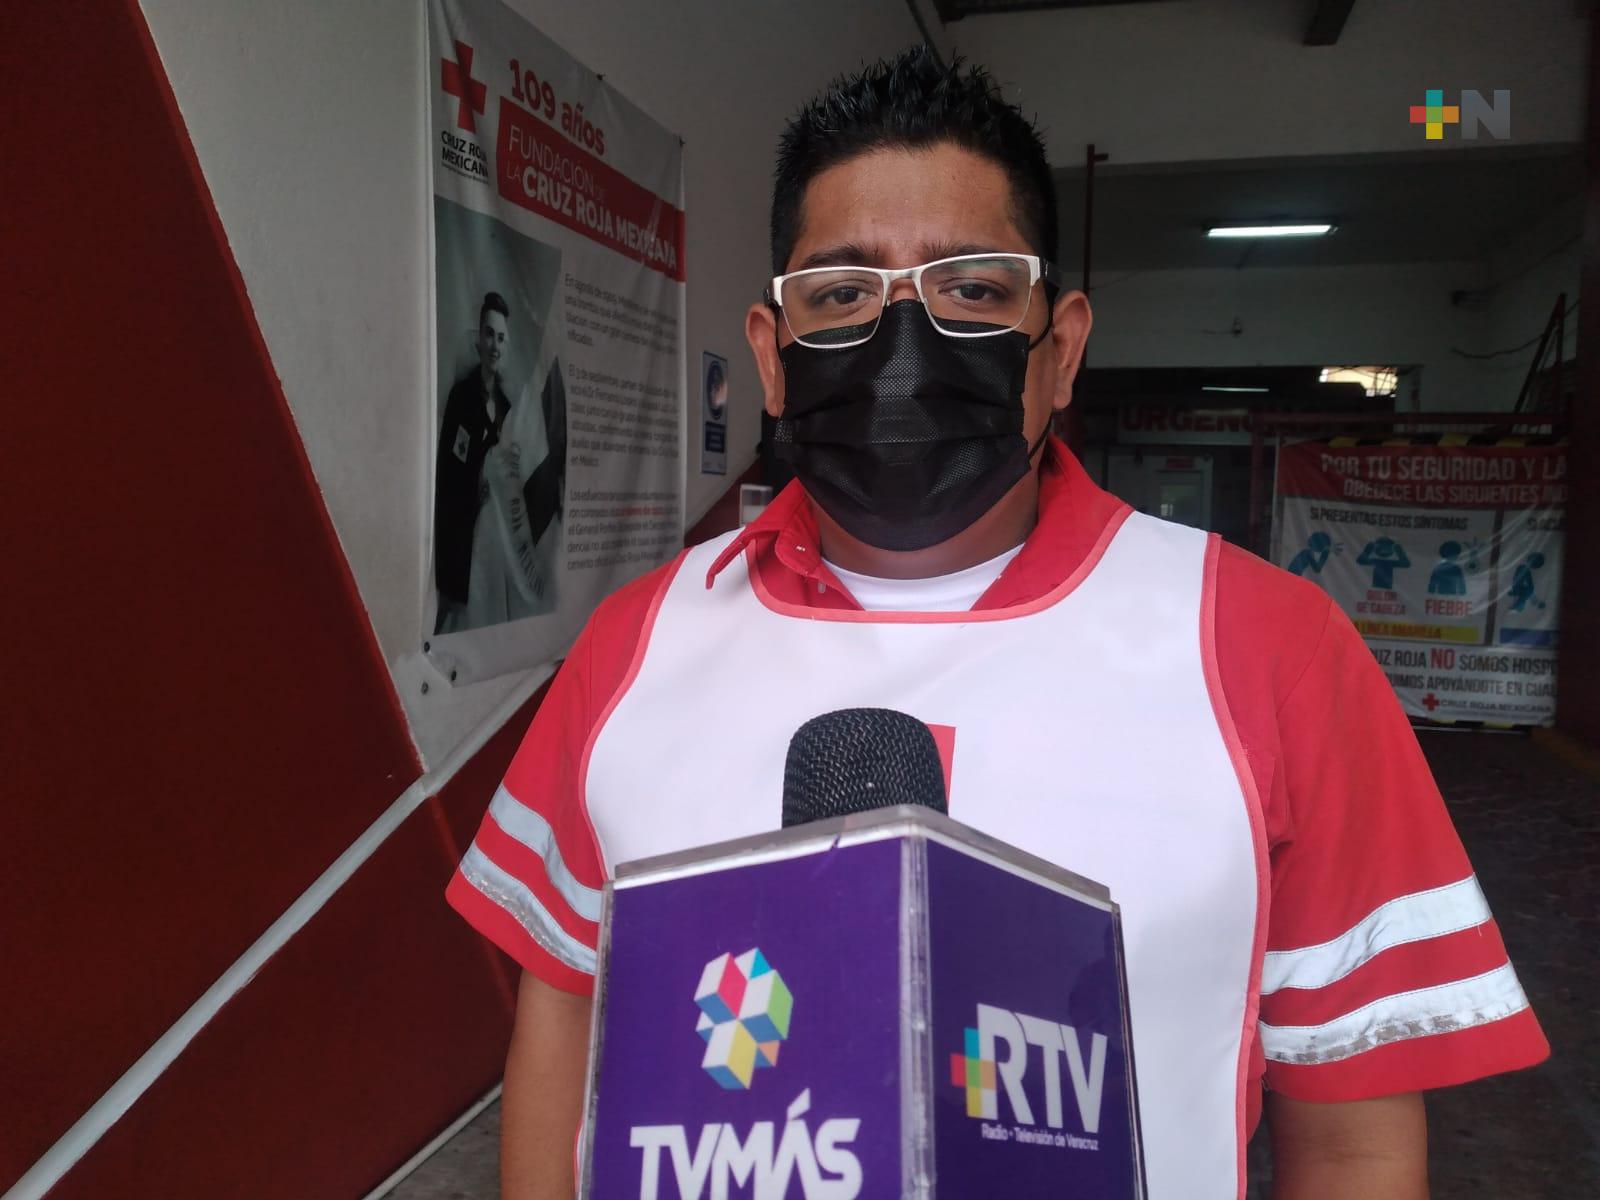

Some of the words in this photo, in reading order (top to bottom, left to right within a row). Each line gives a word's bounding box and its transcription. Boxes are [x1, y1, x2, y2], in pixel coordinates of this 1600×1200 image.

[510, 58, 555, 120] 109
[561, 102, 604, 156] años
[441, 130, 466, 153] CRUZ
[442, 147, 488, 177] MEXICAN
[509, 124, 594, 196] FUNDACIÓN
[506, 161, 521, 184] LA
[522, 165, 573, 216] CRUZ
[575, 193, 614, 239] ROJA
[1320, 453, 1359, 477] POR
[1365, 456, 1391, 479] TU
[1397, 455, 1515, 481] SEGURIDAD
[1522, 457, 1537, 480] Y
[1344, 479, 1410, 502] OBEDECE
[1415, 484, 1445, 503] LAS
[1447, 484, 1539, 504] SIGUIENTES
[1321, 508, 1377, 526] PRESENTAS
[1425, 598, 1472, 616] FIEBRE
[1370, 648, 1391, 665] UZ
[1395, 650, 1426, 668] ROJA
[1431, 648, 1455, 670] NO
[1459, 654, 1508, 673] SOMOS
[1506, 680, 1522, 697] EN
[977, 1002, 1108, 1134] RTV
[981, 1122, 1009, 1141] Radio
[1013, 1126, 1054, 1146] Televisión
[1054, 1131, 1066, 1147] de
[1065, 1133, 1100, 1151] Veracruz
